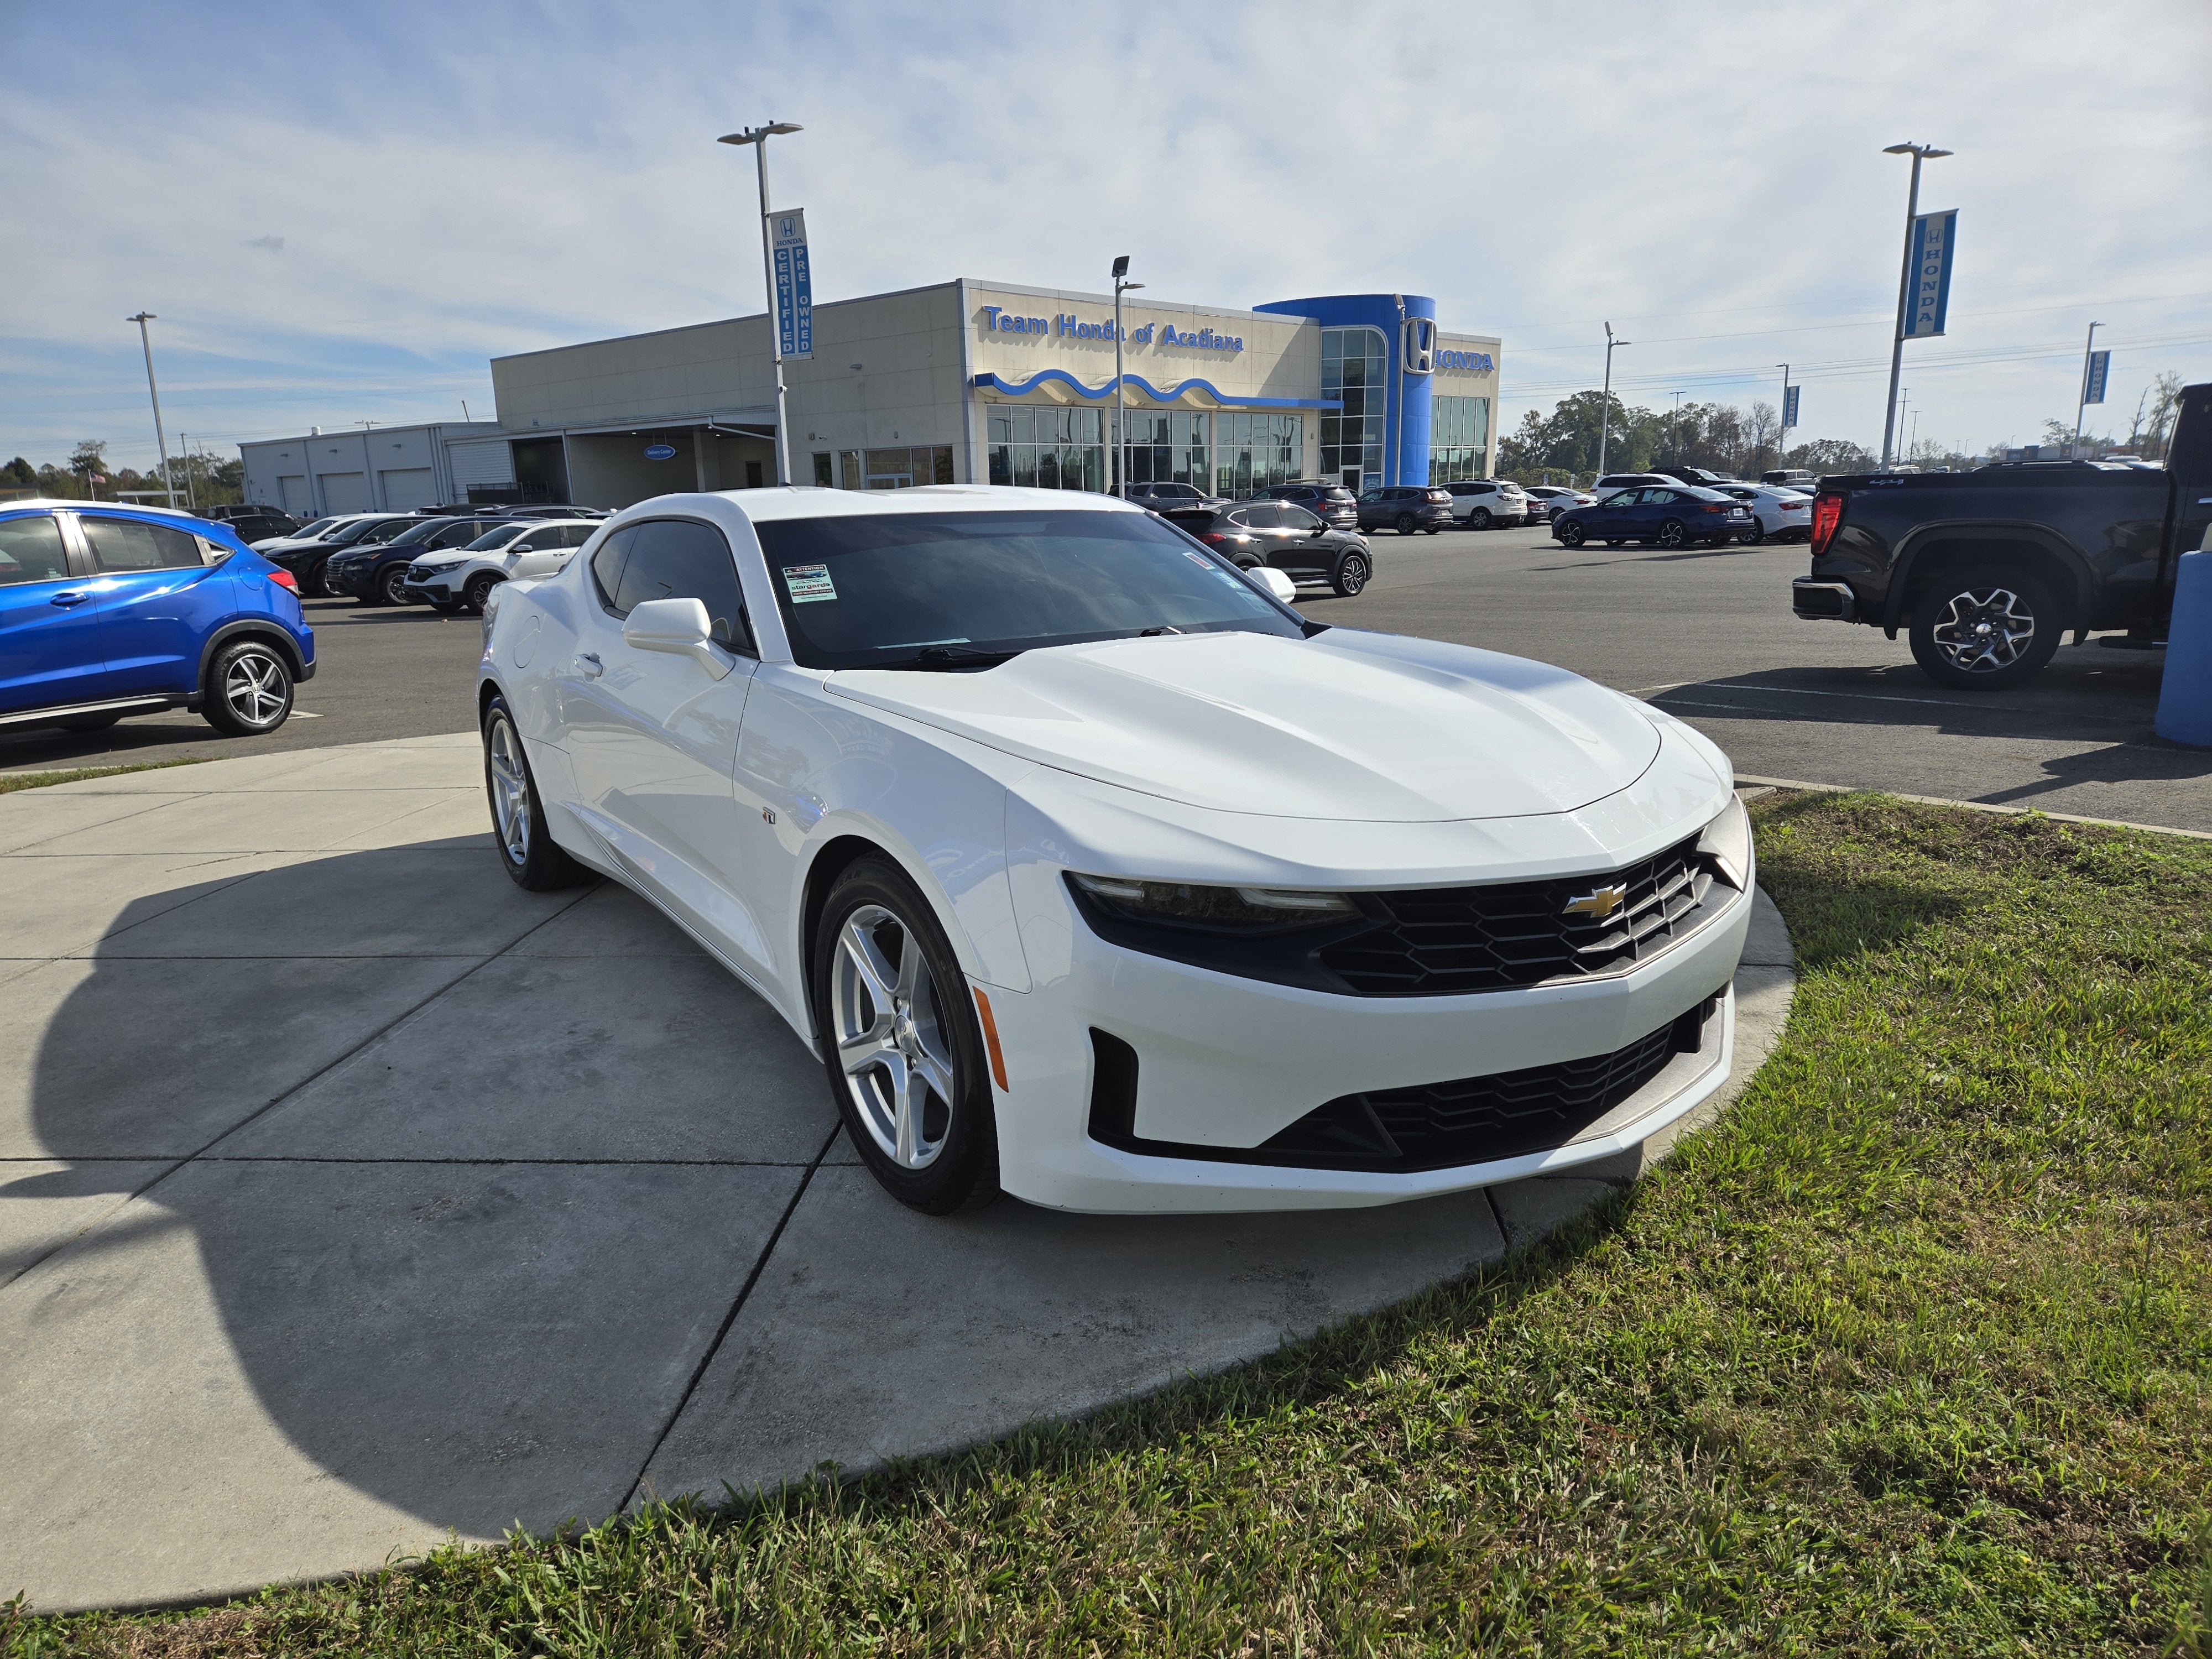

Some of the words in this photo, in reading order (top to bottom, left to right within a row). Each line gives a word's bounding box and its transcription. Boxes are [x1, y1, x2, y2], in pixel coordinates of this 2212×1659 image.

[776, 238, 803, 247] HONDA
[796, 248, 806, 281] PRE
[777, 251, 792, 352] CERTIFIED
[1918, 249, 1940, 322] HONDA
[799, 295, 810, 351] OWNED
[984, 305, 1048, 335] Team
[1135, 322, 1155, 344] of
[1164, 325, 1244, 352] Acadiana
[2092, 366, 2103, 398] HONDA
